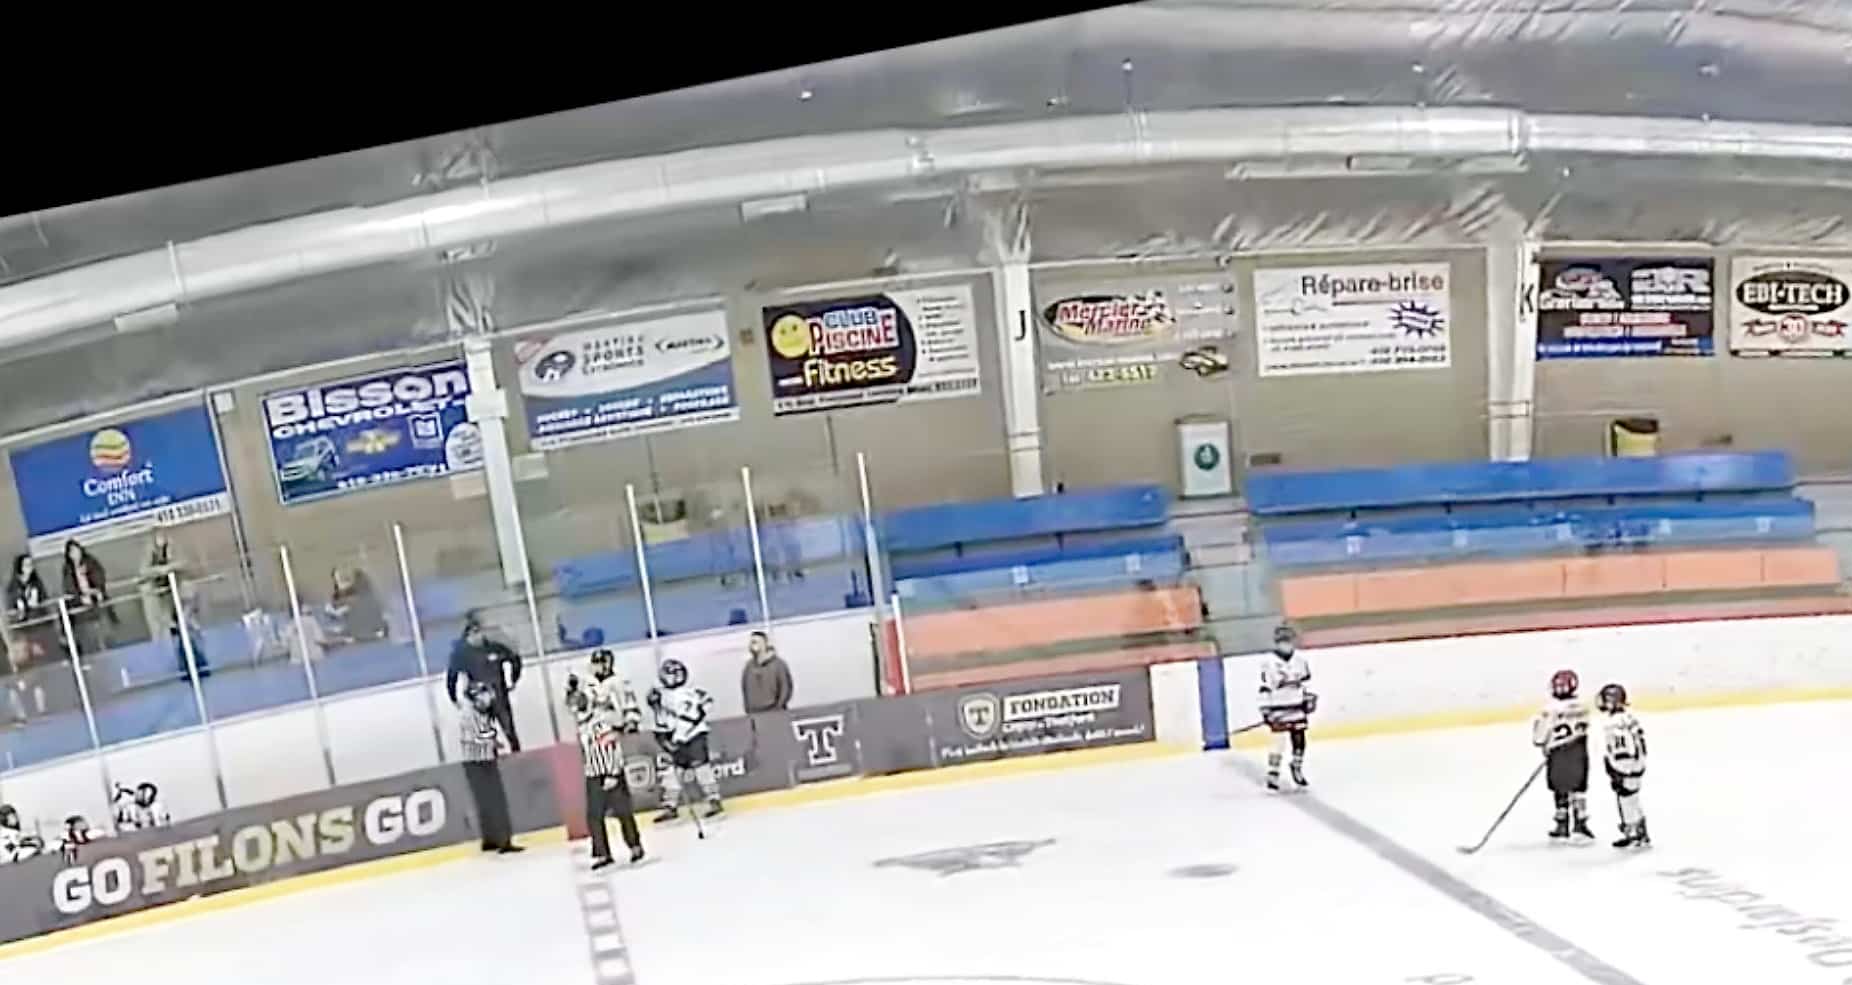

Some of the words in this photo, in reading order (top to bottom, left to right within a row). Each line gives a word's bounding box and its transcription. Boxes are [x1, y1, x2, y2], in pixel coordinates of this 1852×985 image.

[1302, 272, 1444, 297] Répare-brise
[1519, 283, 1535, 318] K
[822, 309, 880, 330] CLUB
[1014, 310, 1027, 341] J
[1058, 300, 1145, 322] Mercier
[808, 313, 898, 356] PISCINE
[803, 354, 898, 388] Fitness
[272, 399, 447, 440] CHEVROLET
[83, 466, 154, 497] Comfort
[1009, 689, 1115, 715] FONDATION
[791, 714, 844, 766] T
[52, 856, 132, 914] GO
[136, 806, 356, 896] FILONS
[363, 787, 447, 847] GO
